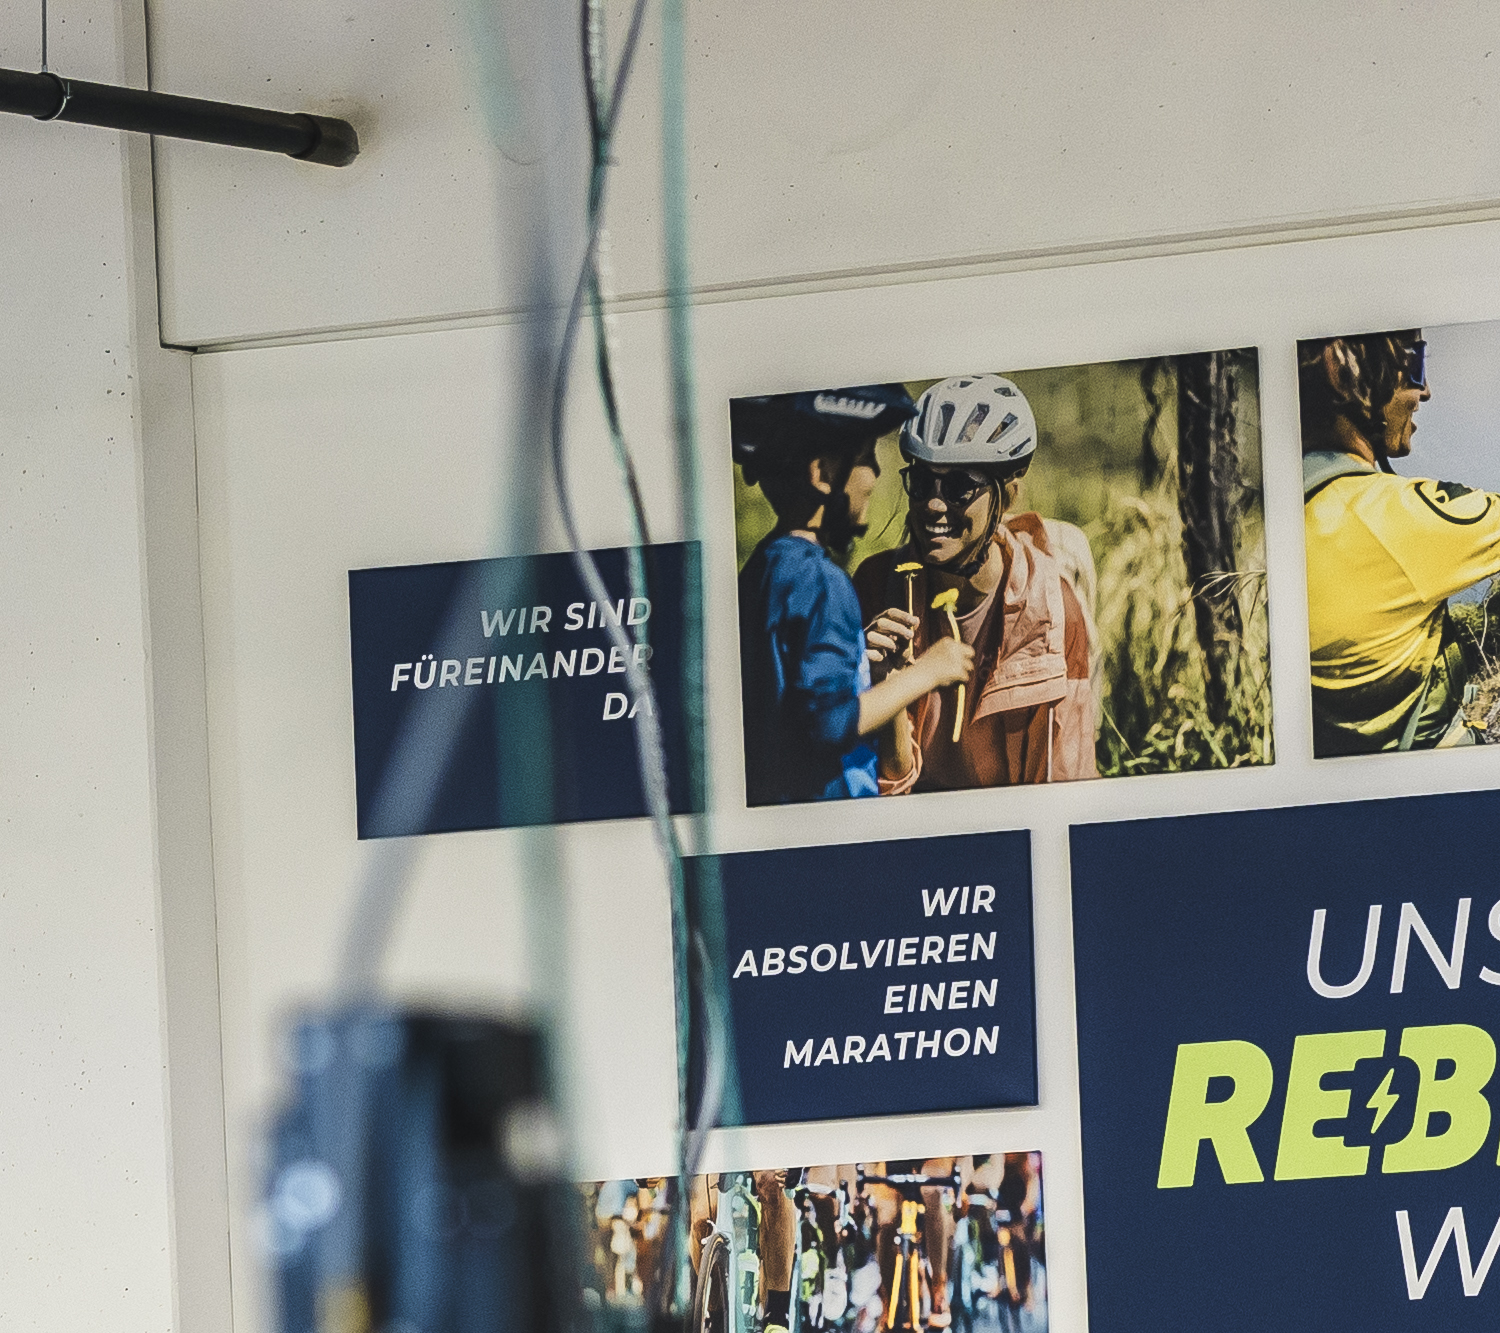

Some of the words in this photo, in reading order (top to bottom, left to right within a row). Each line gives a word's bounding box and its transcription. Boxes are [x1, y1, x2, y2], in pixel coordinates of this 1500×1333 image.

[480, 605, 552, 638] WIR
[564, 597, 652, 631] SIND
[921, 884, 996, 917] WIR
[732, 931, 997, 979] ABSOLVIEREN
[883, 978, 998, 1015] EINEN
[783, 1025, 999, 1069] MARATHON
